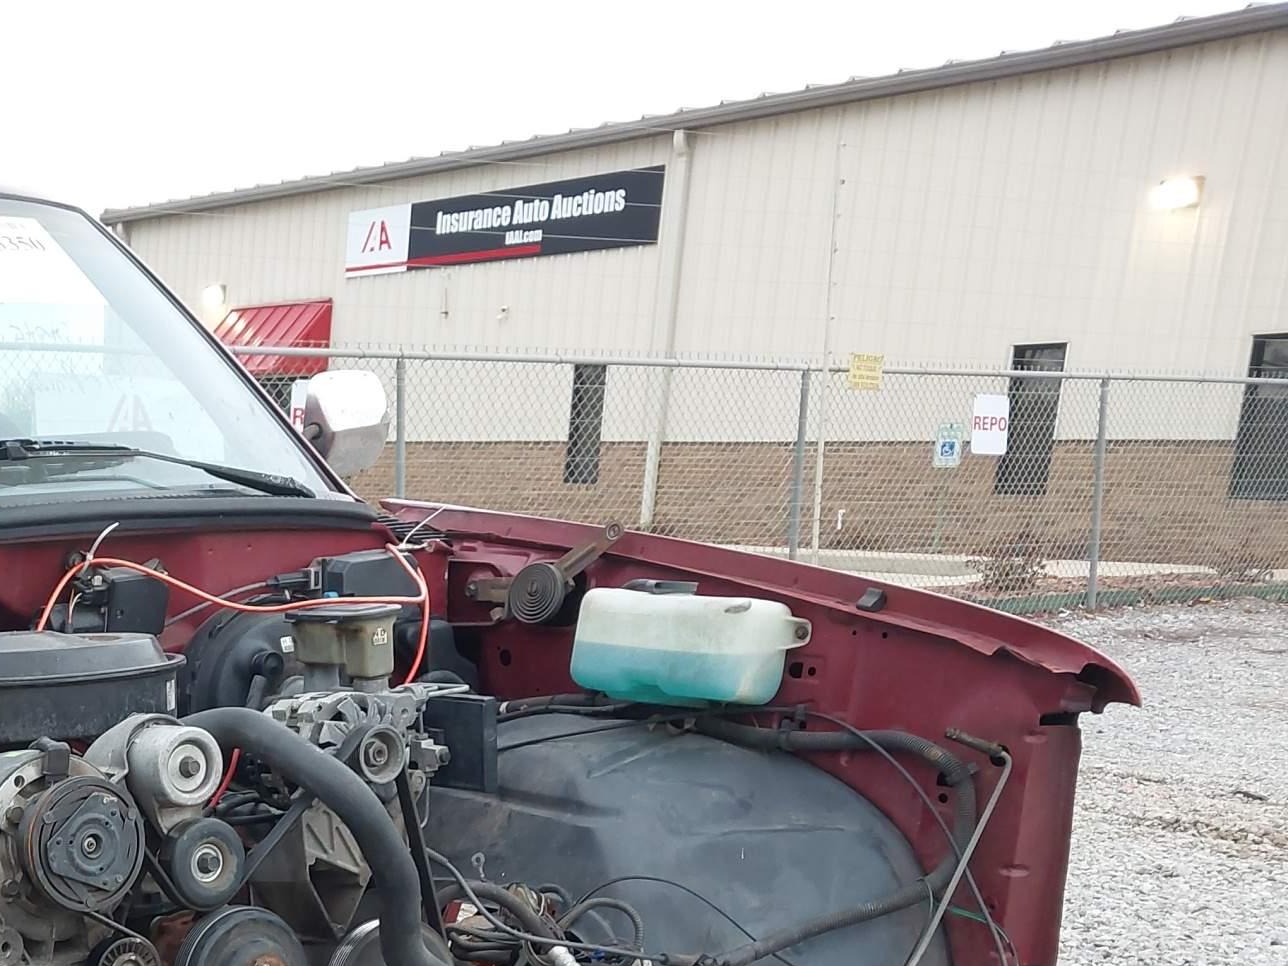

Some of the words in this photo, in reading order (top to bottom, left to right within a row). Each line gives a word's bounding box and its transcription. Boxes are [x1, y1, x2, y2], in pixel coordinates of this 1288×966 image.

[435, 205, 512, 235] Insurance
[512, 199, 550, 225] Auto
[550, 188, 626, 220] Auctions
[504, 229, 543, 245] IAAI.com
[973, 415, 1007, 432] REPO
